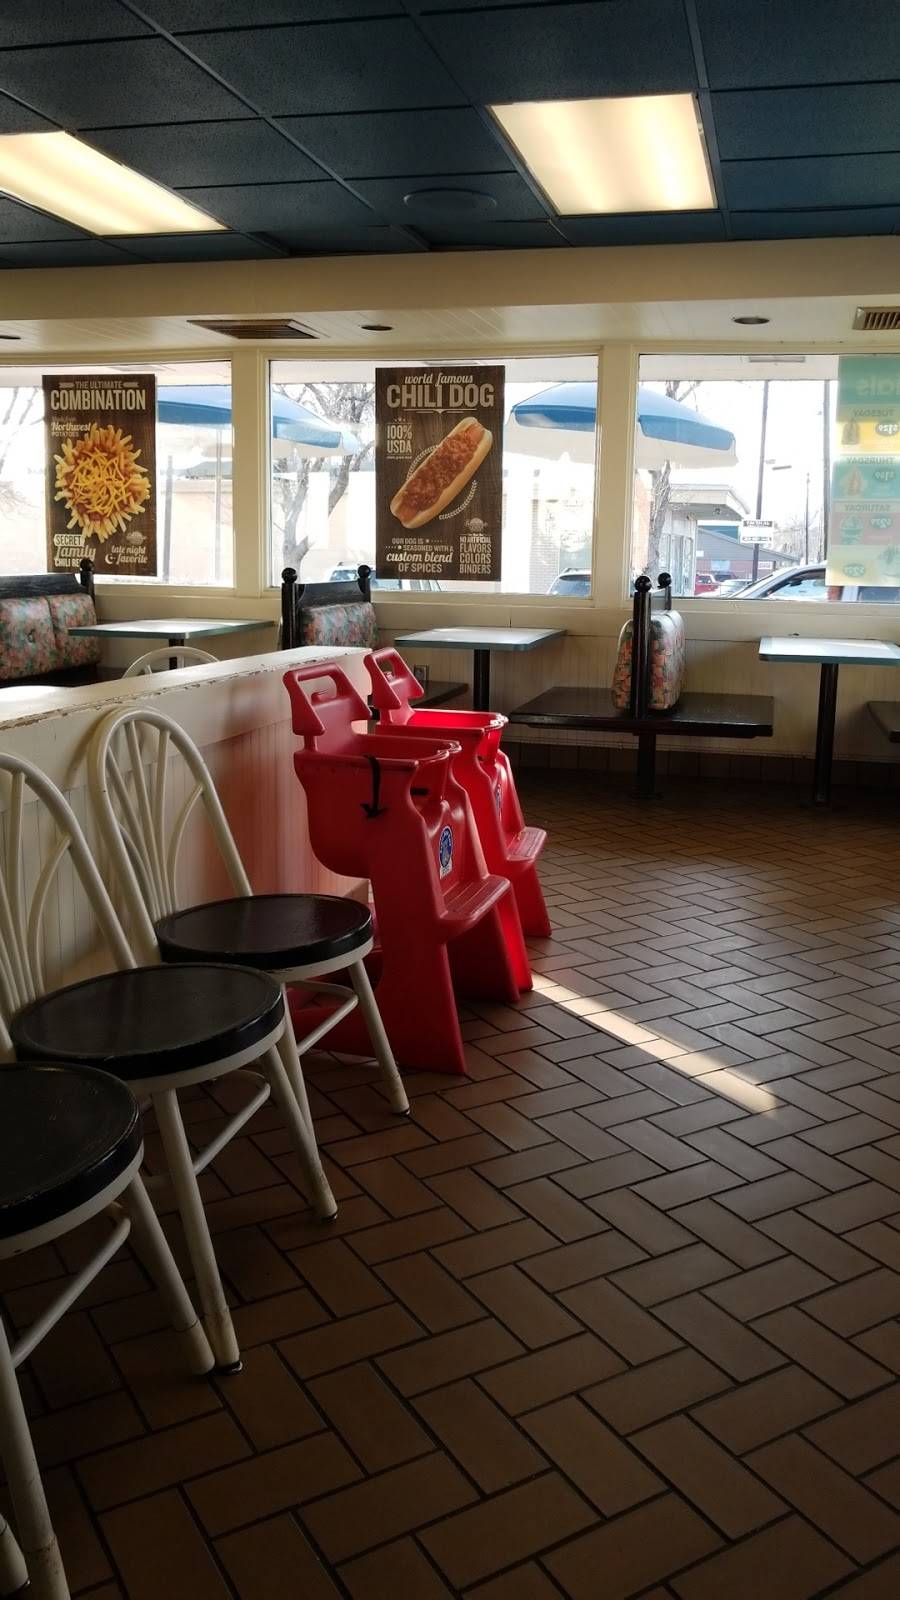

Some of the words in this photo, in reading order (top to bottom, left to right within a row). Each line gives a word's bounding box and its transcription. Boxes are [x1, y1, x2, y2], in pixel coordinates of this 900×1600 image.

[75, 381, 89, 389] THE
[90, 381, 123, 389] ULTIMATE
[404, 373, 434, 385] world
[434, 372, 474, 389] famous
[50, 389, 147, 410] COMBINATION
[387, 385, 443, 408] CHILI
[448, 383, 495, 408] DOG
[50, 421, 91, 431] Northwest
[387, 425, 413, 440] 100%
[387, 439, 413, 454] USDA
[56, 535, 81, 546] SECRET
[391, 537, 405, 545] OUR
[405, 537, 417, 545] DOG
[417, 537, 424, 545] IS
[460, 535, 467, 544] NO
[467, 535, 492, 544] ARTIFICIAL
[56, 545, 97, 561] family
[111, 545, 125, 554] late
[126, 546, 147, 555] night
[403, 544, 433, 552] SEASONED
[433, 544, 449, 552] WITH
[460, 543, 492, 553] FLAVORS
[115, 554, 148, 565] favorite
[386, 550, 423, 562] custom
[424, 550, 453, 562] blend
[460, 552, 492, 564] COLORS
[54, 558, 71, 567] CHILI
[398, 562, 410, 573] OF
[410, 562, 443, 573] SPICES
[460, 563, 492, 575] BINDERS
